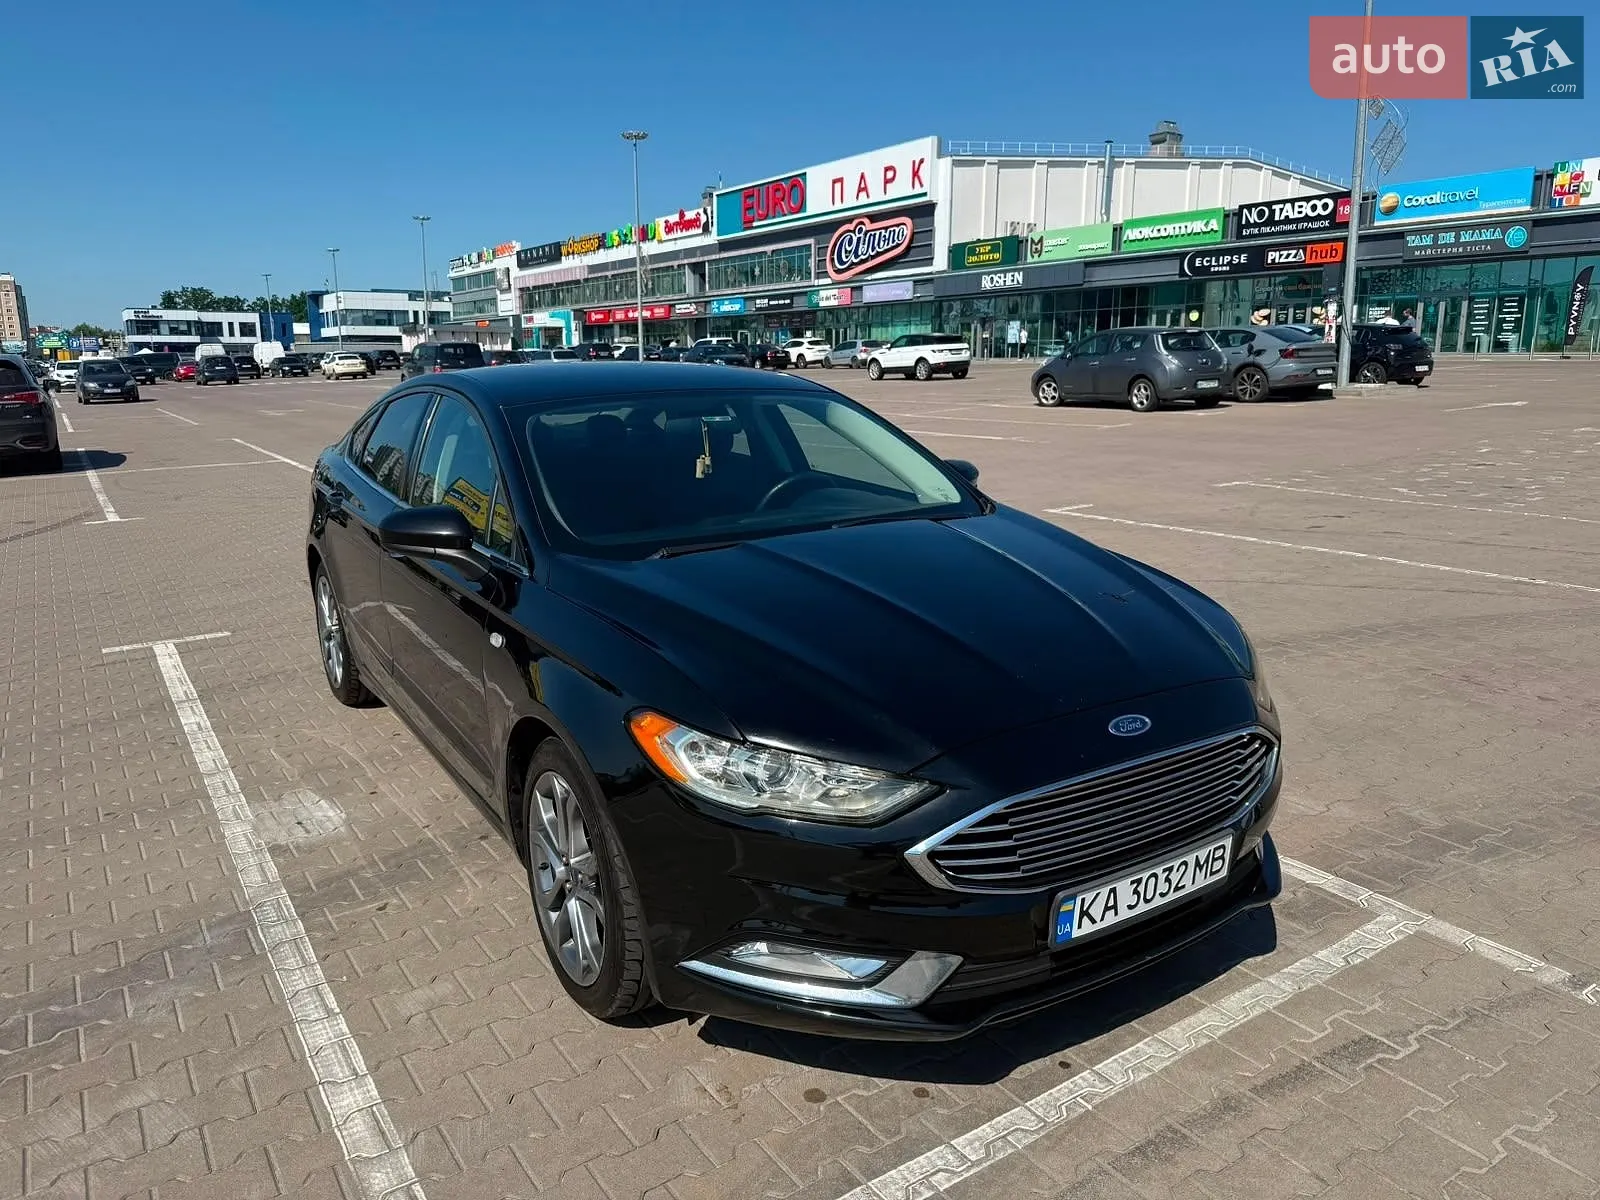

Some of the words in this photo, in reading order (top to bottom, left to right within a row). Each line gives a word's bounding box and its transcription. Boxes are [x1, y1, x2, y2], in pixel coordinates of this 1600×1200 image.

[832, 157, 924, 206] ПАРК
[742, 176, 804, 226] EURO
[1241, 206, 1269, 225] NO
[1271, 198, 1334, 221] TABOO
[1242, 226, 1260, 236] БУТІК
[1260, 224, 1297, 234] ПІКАНТНИХ
[1298, 220, 1330, 230] ІГРАШОК
[1406, 234, 1434, 247] TAM
[1438, 232, 1455, 245] DE
[1460, 227, 1503, 243] MAMA
[521, 244, 554, 260] HANAMI
[561, 238, 599, 257] WORKSHOP
[834, 225, 907, 270] Сільпо
[1267, 248, 1305, 264] PIZZA
[1309, 245, 1338, 262] hub
[1414, 246, 1463, 256] МАЙСТЕРНЯ
[1467, 244, 1491, 253] ТІСТА
[1195, 253, 1248, 267] ECLIPSE
[981, 271, 1023, 290] ROSHEN
[1119, 718, 1143, 732] Ford
[1076, 885, 1119, 930] KA
[1126, 860, 1188, 911] 3032
[1191, 844, 1227, 886] MB
[1057, 922, 1071, 936] UA
